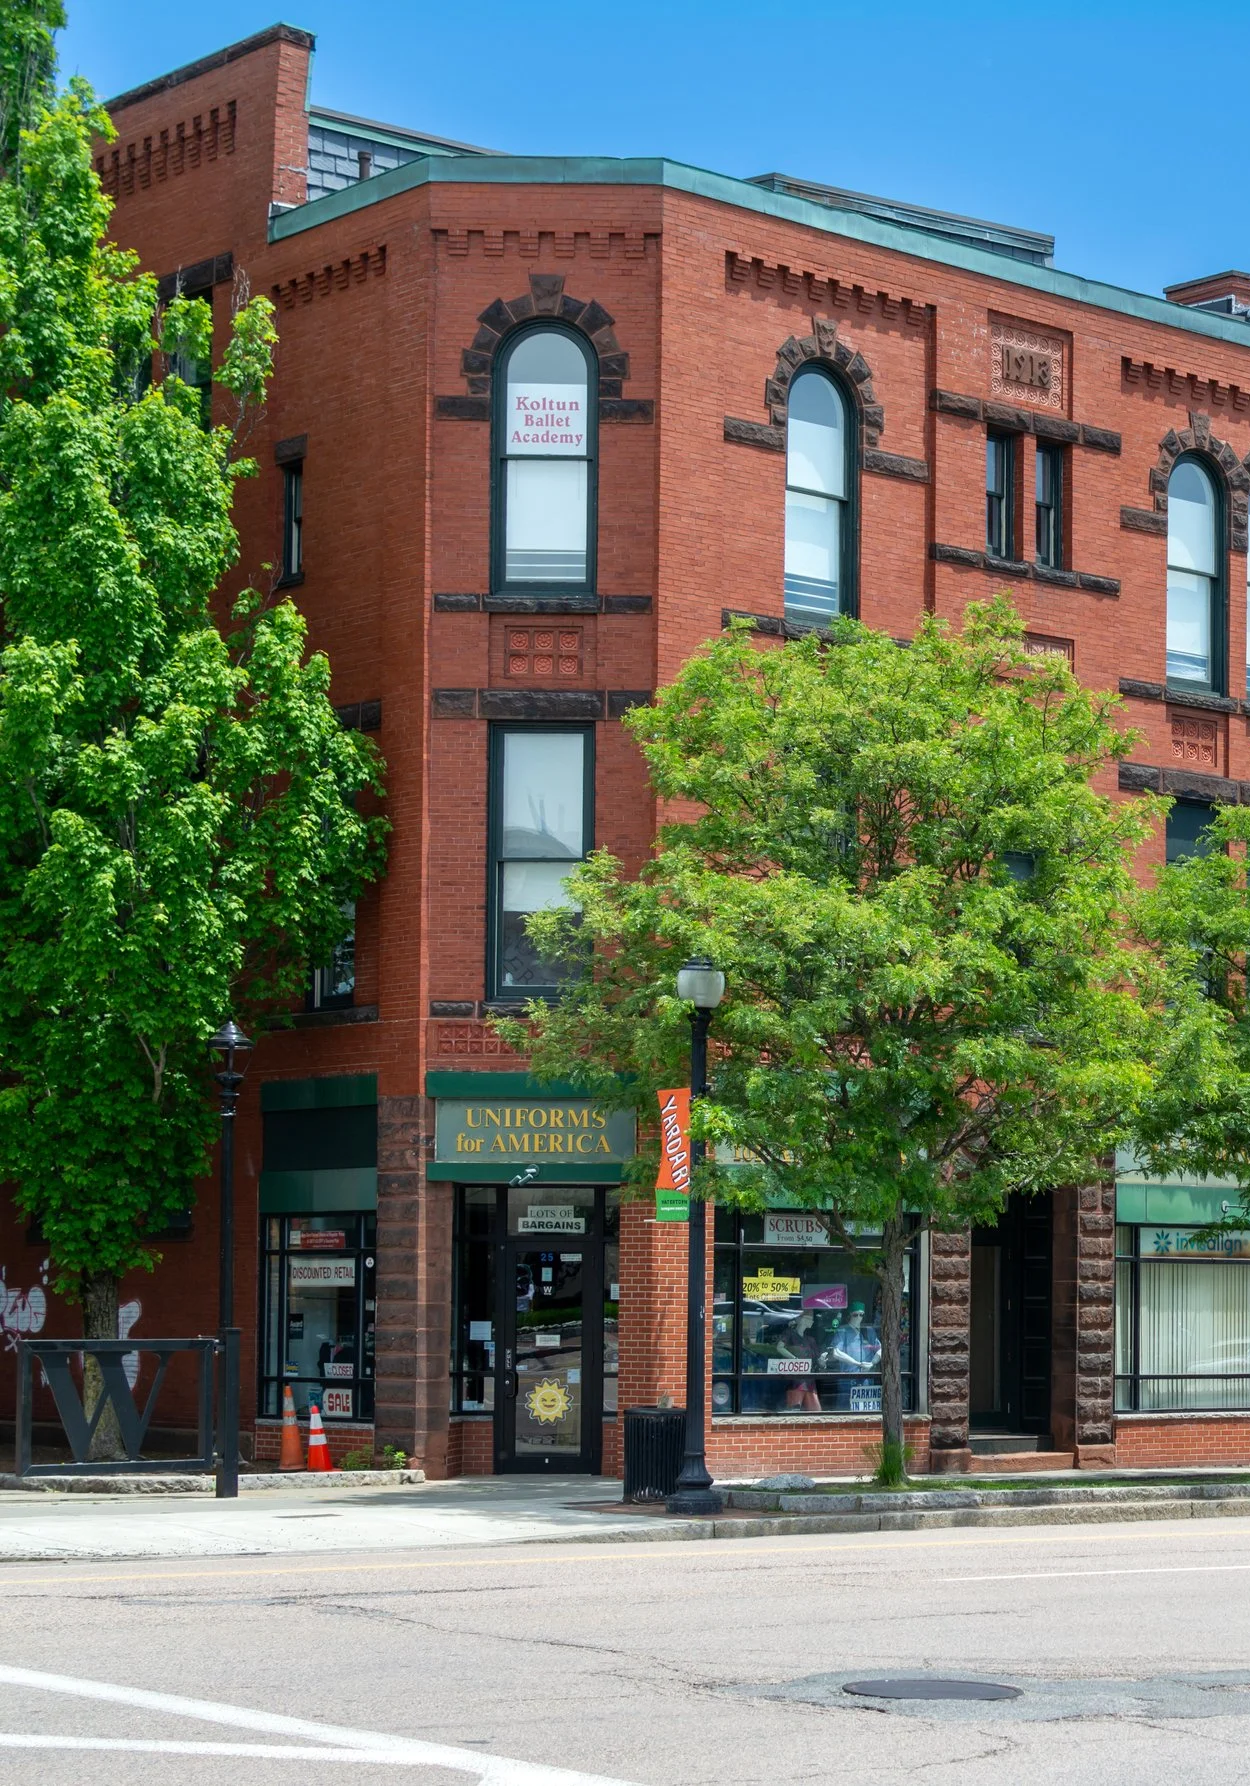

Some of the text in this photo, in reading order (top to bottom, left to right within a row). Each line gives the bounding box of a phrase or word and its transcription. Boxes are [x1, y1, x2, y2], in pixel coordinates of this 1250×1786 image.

[515, 396, 580, 411] Koltun
[524, 414, 570, 427] Ballet
[511, 430, 583, 447] Academy
[466, 1108, 607, 1129] UNIFORMS
[456, 1133, 611, 1153] for AMERICA
[661, 1094, 691, 1192] YARDART
[530, 1209, 573, 1218] LOTS OF
[522, 1220, 581, 1230] BARGAINS
[768, 1218, 824, 1234] SCRUBS
[777, 1233, 795, 1242] From
[1176, 1231, 1242, 1256] invsalign
[540, 1253, 554, 1262] 25
[292, 1266, 355, 1280] DISCOUNTED RETAIL
[759, 1269, 774, 1277] Sale
[742, 1282, 760, 1292] 20%
[771, 1282, 789, 1292] 50%
[332, 1365, 353, 1377] CLOSED
[777, 1361, 810, 1373] CLOSED
[852, 1388, 882, 1400] PARKING
[327, 1393, 350, 1412] SALE
[852, 1402, 881, 1411] IN REAR
